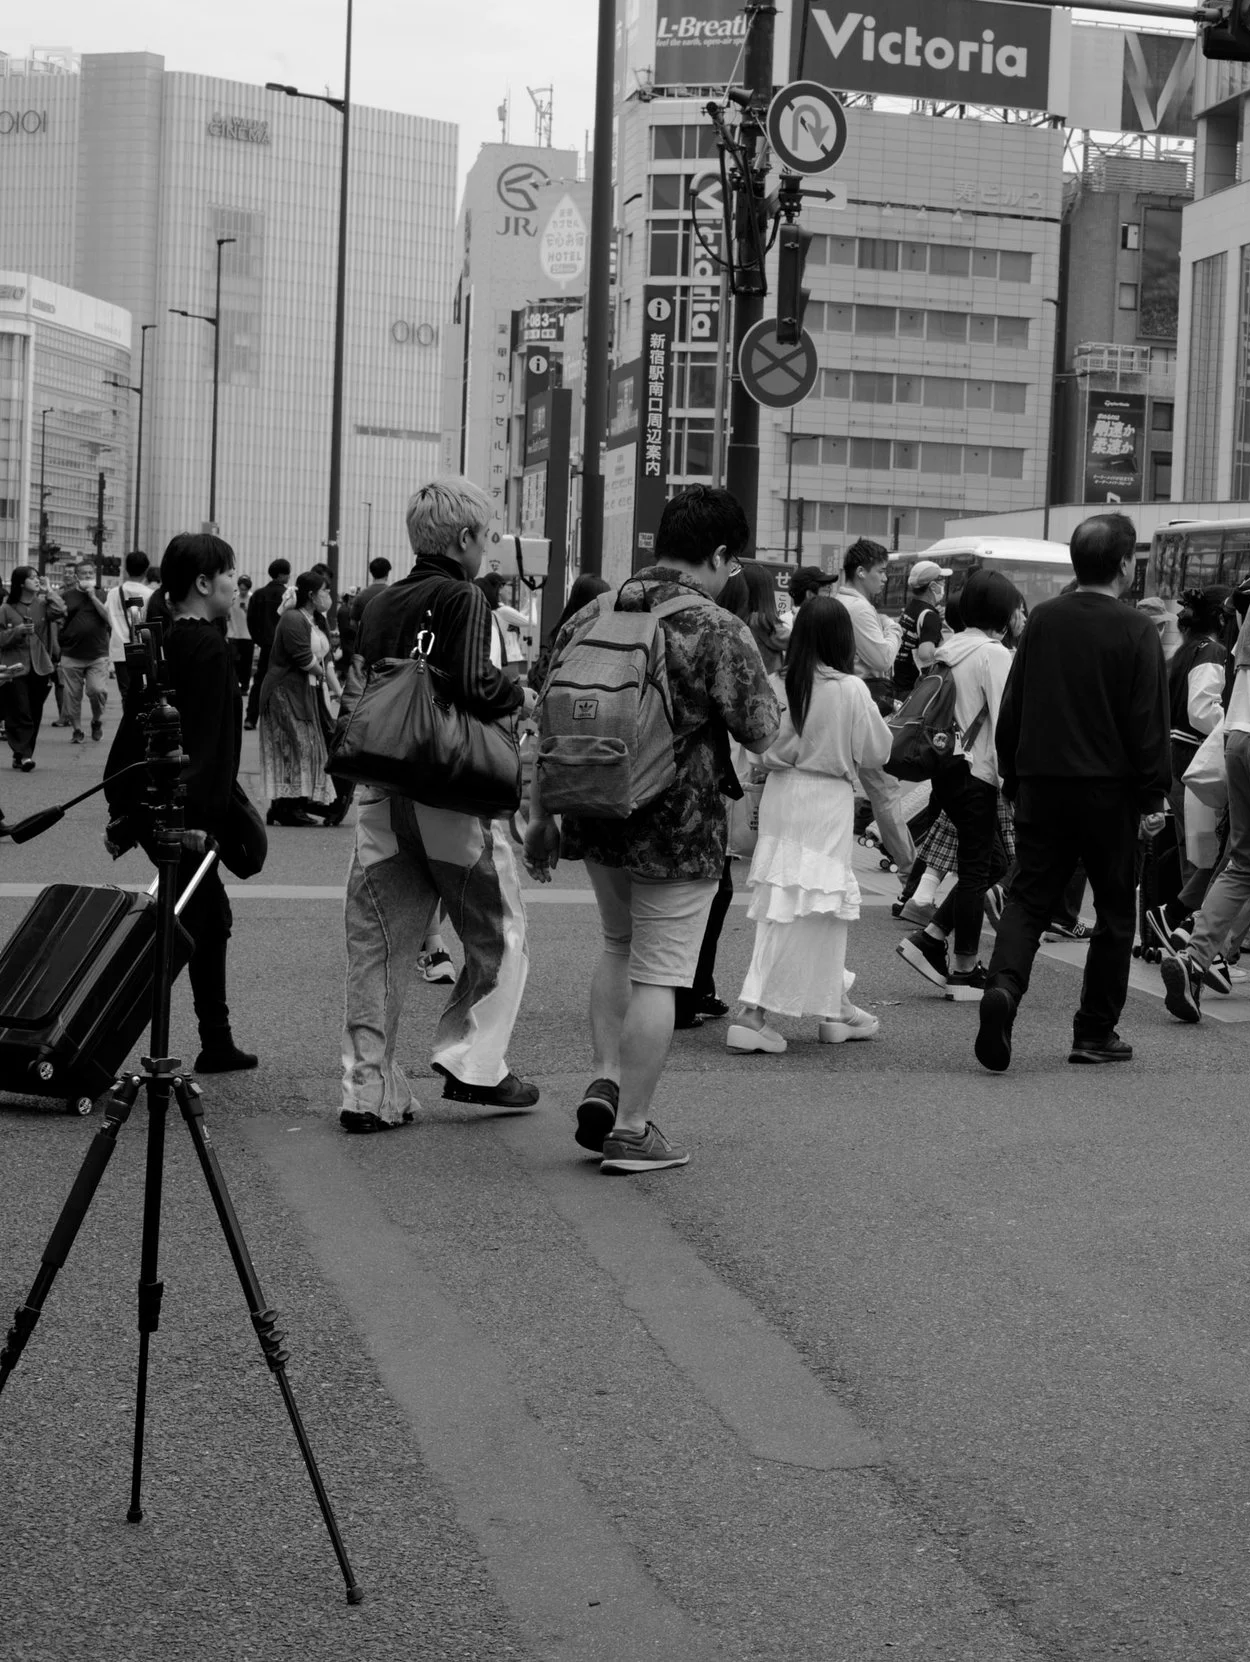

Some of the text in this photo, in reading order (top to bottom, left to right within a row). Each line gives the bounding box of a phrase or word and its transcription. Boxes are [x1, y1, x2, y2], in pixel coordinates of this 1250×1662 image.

[811, 8, 1028, 78] Victoria
[548, 251, 583, 262] HOTEL
[645, 333, 666, 477] 新宿駅南口周辺案内
